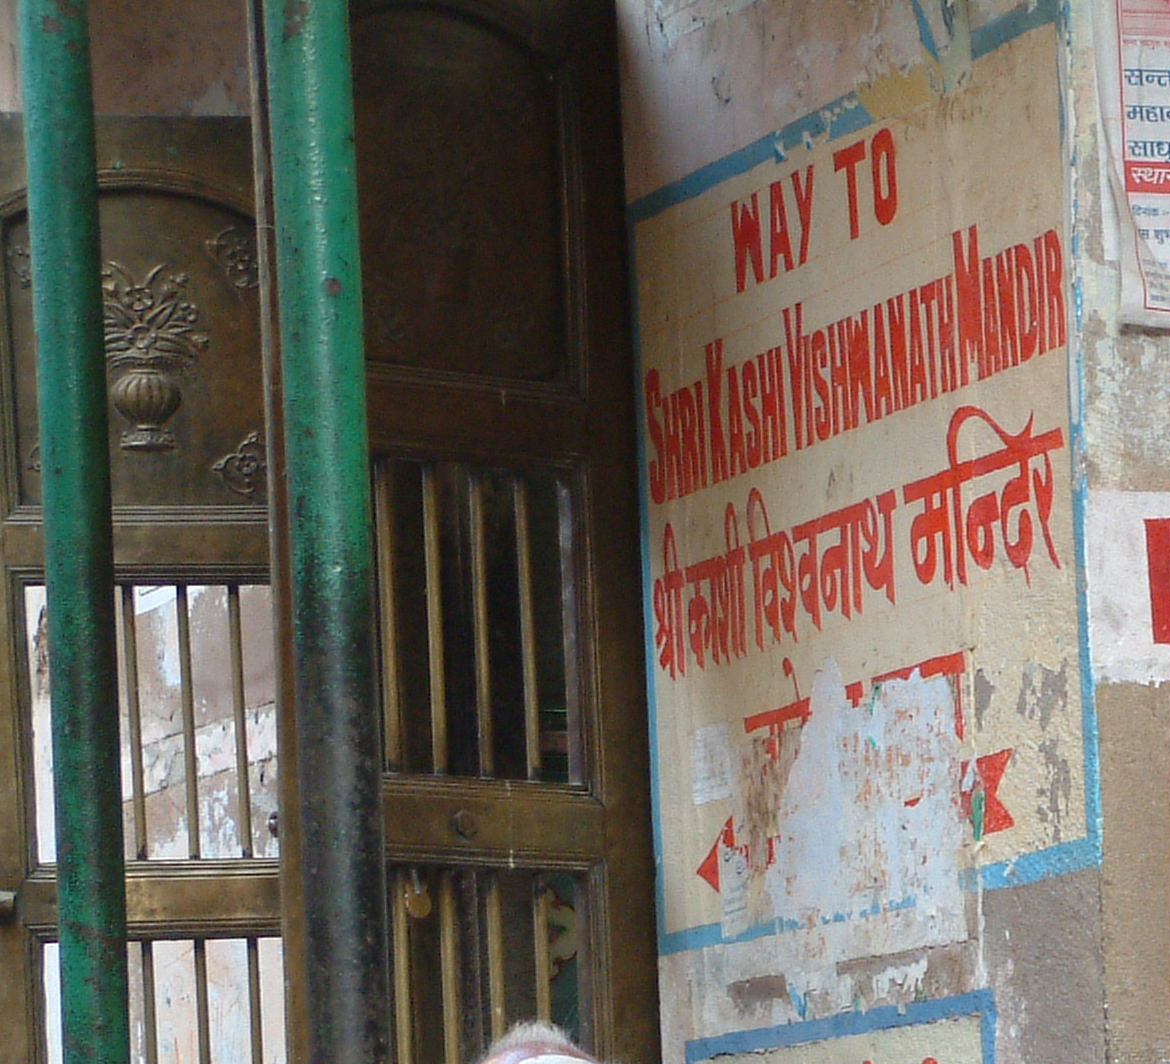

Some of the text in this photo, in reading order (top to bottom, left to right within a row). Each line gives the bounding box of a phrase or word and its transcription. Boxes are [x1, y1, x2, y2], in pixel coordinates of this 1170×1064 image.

[730, 128, 898, 293] WAY TO
[645, 224, 1066, 504] SHRI KASHI VISHWANATH MANDIR
[654, 523, 686, 681] श्री
[685, 502, 747, 671] काशी
[747, 488, 896, 653] विश्वनाथ
